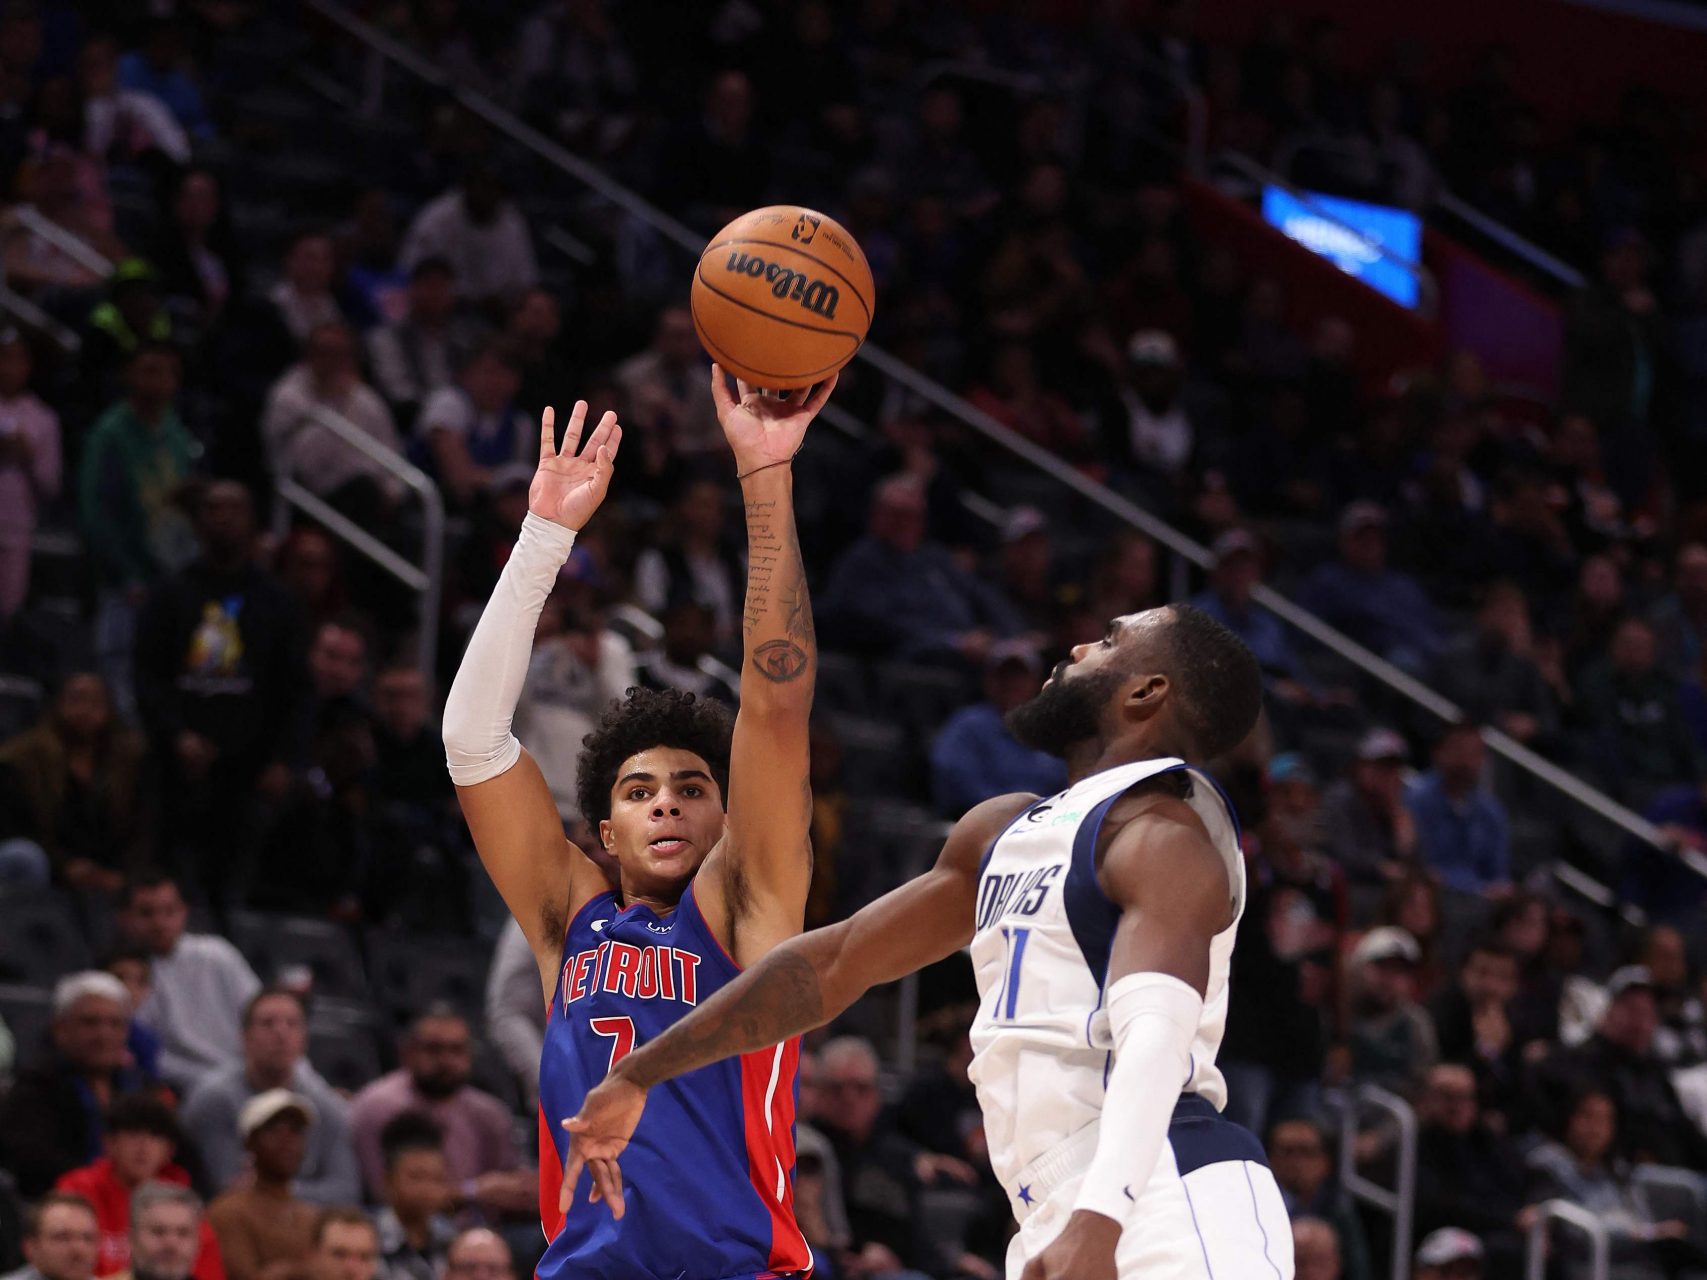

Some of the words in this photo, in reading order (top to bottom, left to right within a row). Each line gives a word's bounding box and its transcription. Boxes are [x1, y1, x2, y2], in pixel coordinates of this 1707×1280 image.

[726, 252, 840, 321] Wilson
[561, 940, 702, 1019] DETROIT
[589, 1015, 636, 1077] 7
